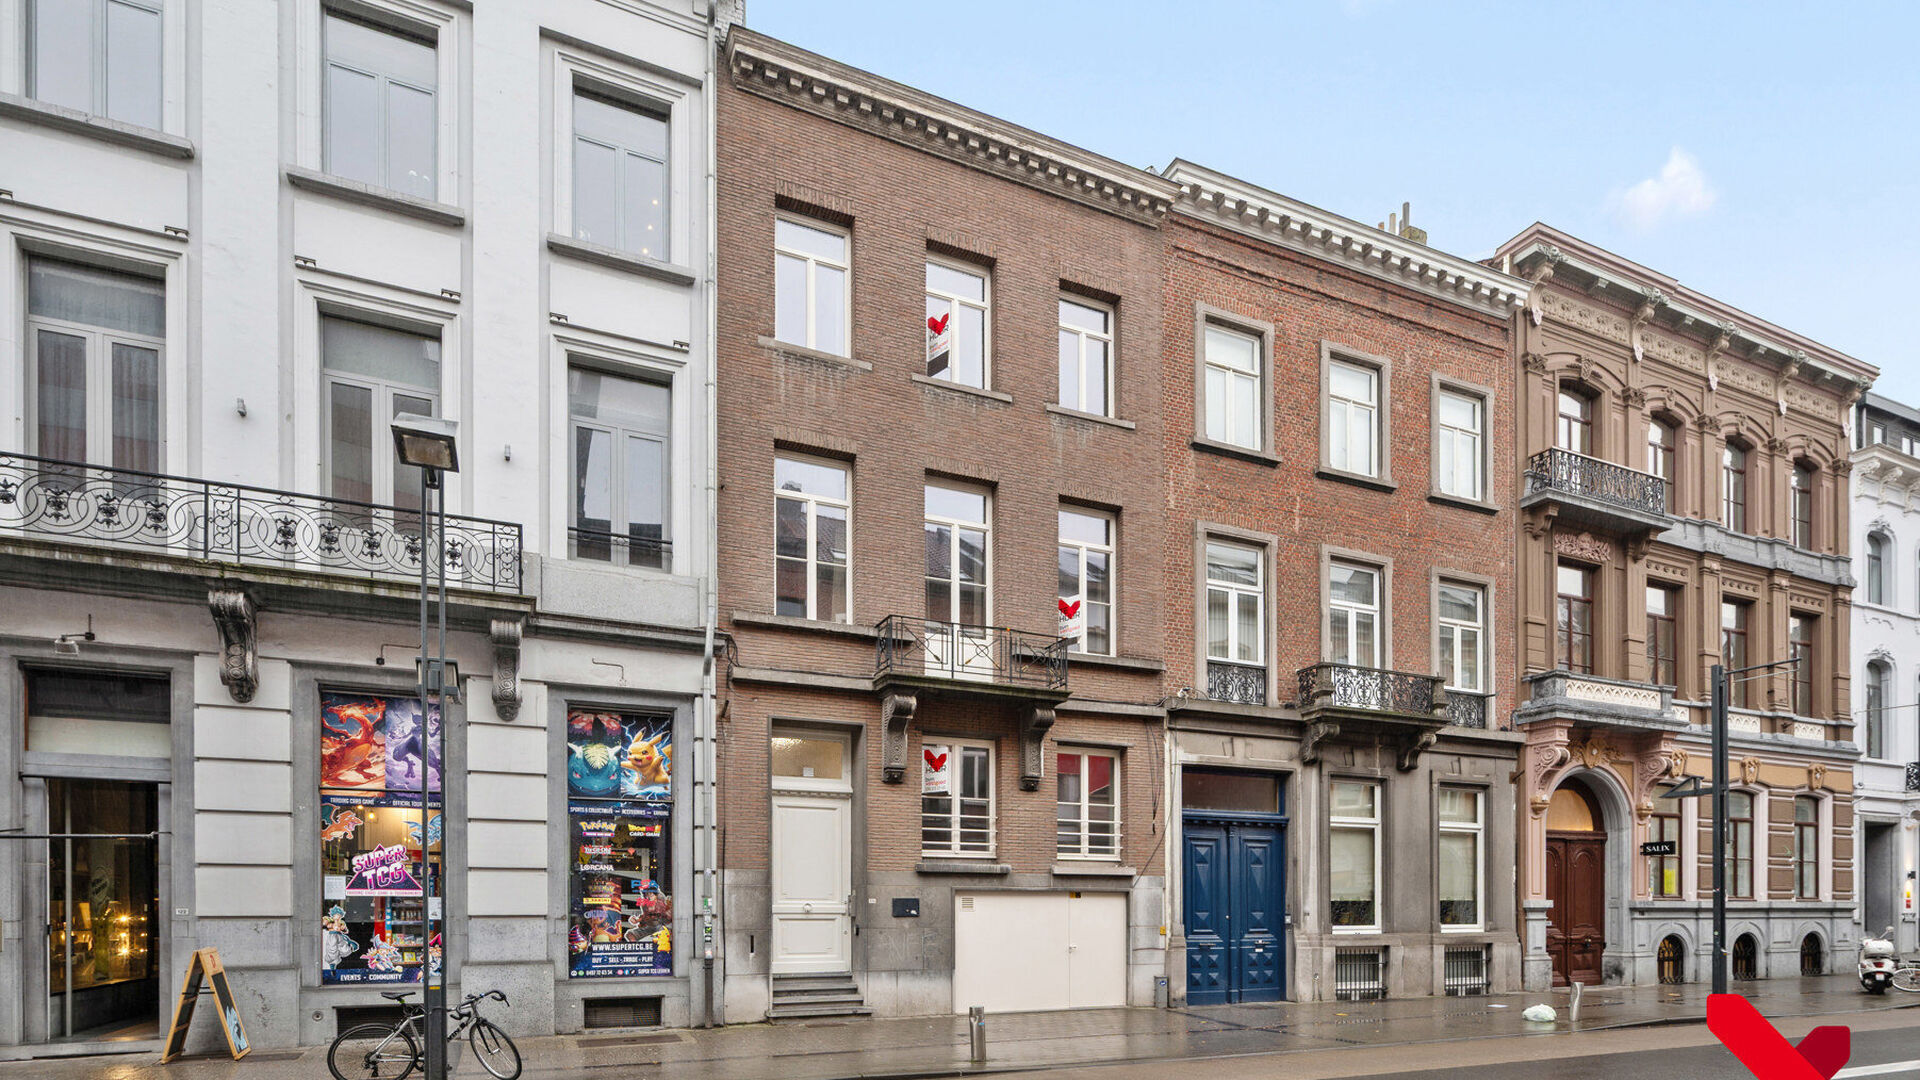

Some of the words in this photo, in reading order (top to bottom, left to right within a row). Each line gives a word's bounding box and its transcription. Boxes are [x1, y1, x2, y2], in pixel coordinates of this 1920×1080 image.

[352, 844, 408, 872] SUPER
[362, 862, 406, 890] TCG
[592, 943, 653, 951] WWW.SUPERTCG.BE
